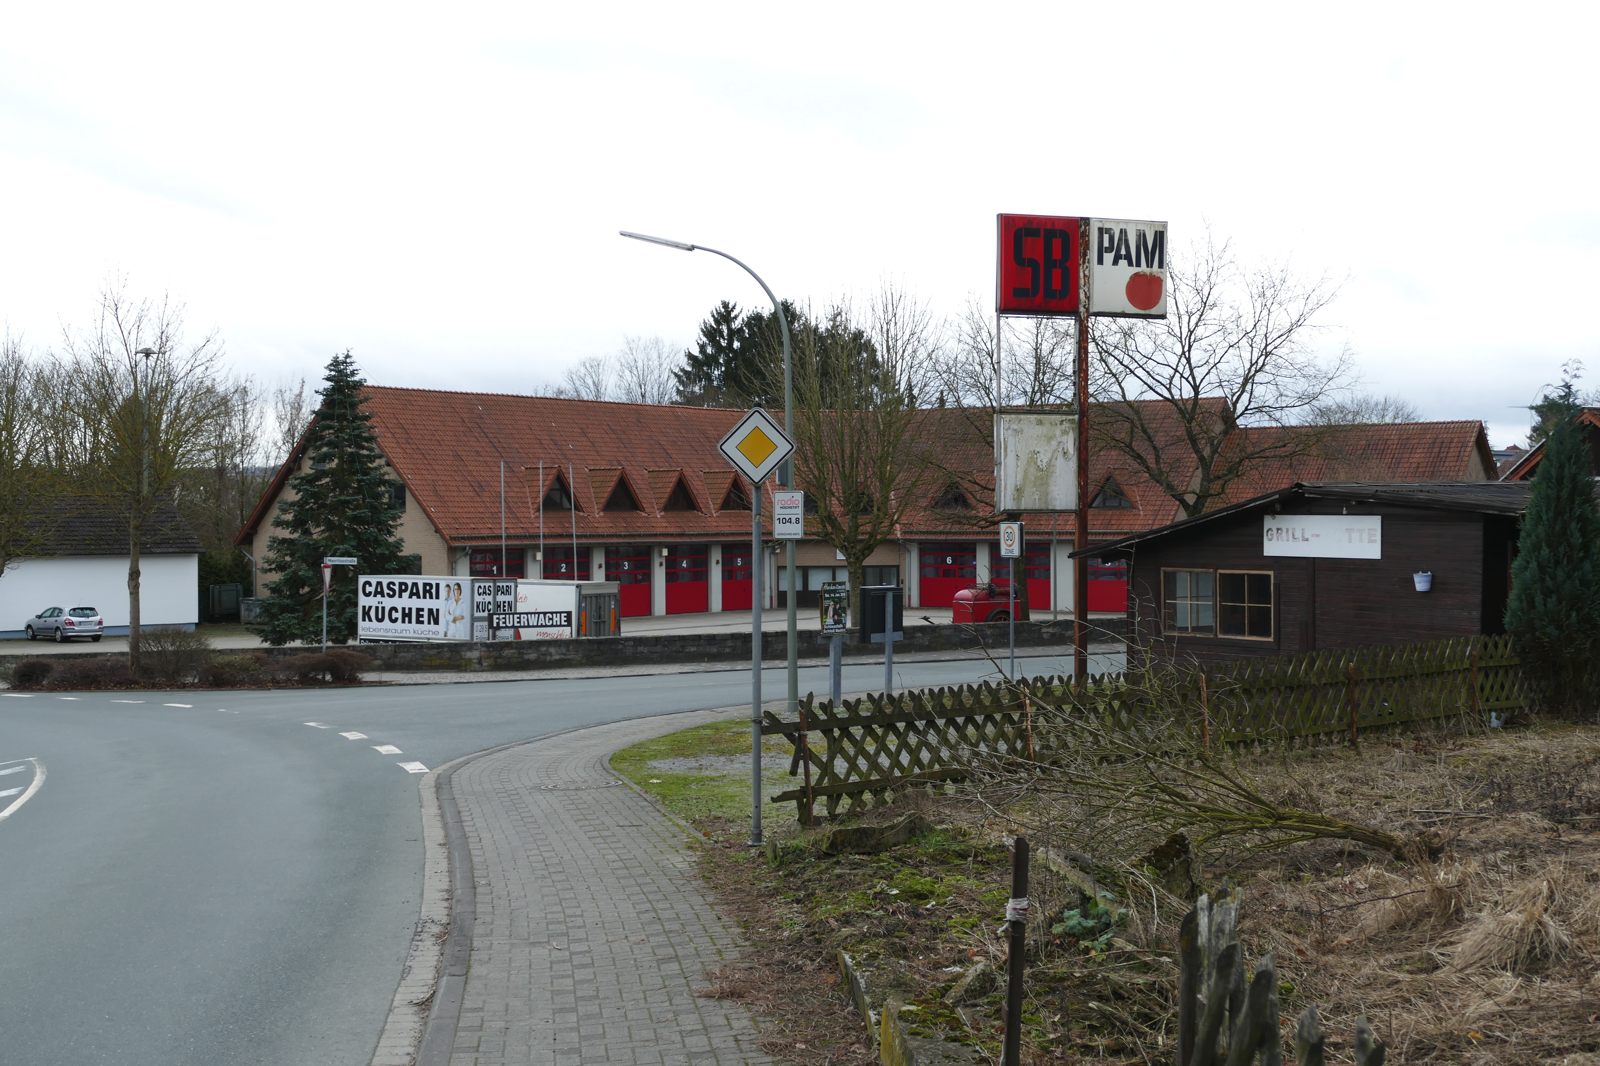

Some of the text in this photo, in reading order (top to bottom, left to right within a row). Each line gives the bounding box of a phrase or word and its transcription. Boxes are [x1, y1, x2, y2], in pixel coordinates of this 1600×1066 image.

[1096, 226, 1165, 269] PAM
[1012, 227, 1070, 299] SB
[776, 495, 800, 506] radio
[776, 517, 800, 525] 104.8
[1005, 531, 1014, 542] 30
[623, 561, 629, 570] 3
[681, 559, 687, 568] 4
[737, 558, 742, 566] 5
[946, 556, 952, 565] 6
[492, 565, 497, 574] 1
[560, 563, 567, 573] 2
[361, 580, 440, 600] CASPARI
[361, 601, 440, 625] KÜCHEN
[492, 613, 568, 628] FEUERWACHE
[361, 626, 411, 635] lebensraum
